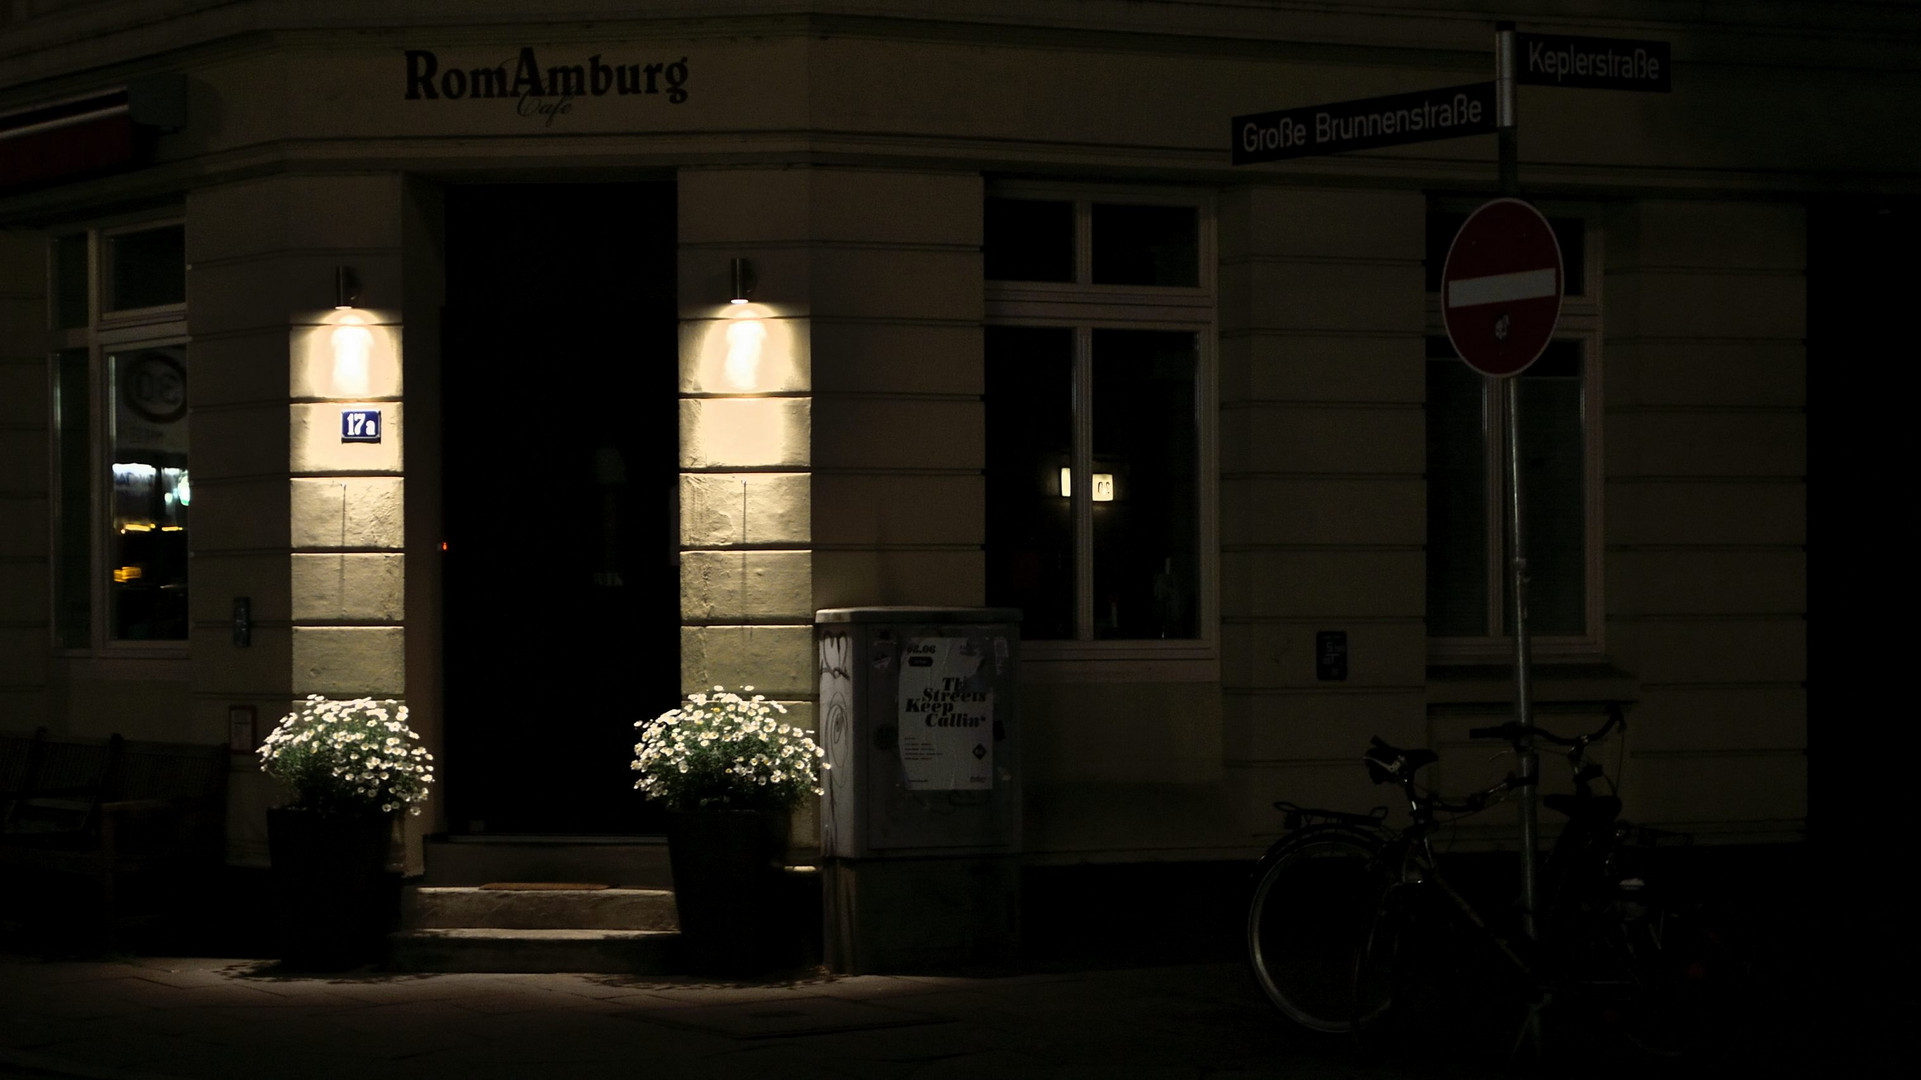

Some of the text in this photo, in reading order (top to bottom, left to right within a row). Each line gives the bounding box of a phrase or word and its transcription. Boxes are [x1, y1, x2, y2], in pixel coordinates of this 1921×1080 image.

[405, 47, 688, 104] RomAmburg
[1528, 40, 1660, 83] Keplerstraße
[1242, 92, 1483, 152] Große Brunnenstraße
[347, 413, 376, 435] 17a
[906, 698, 954, 716] Keep
